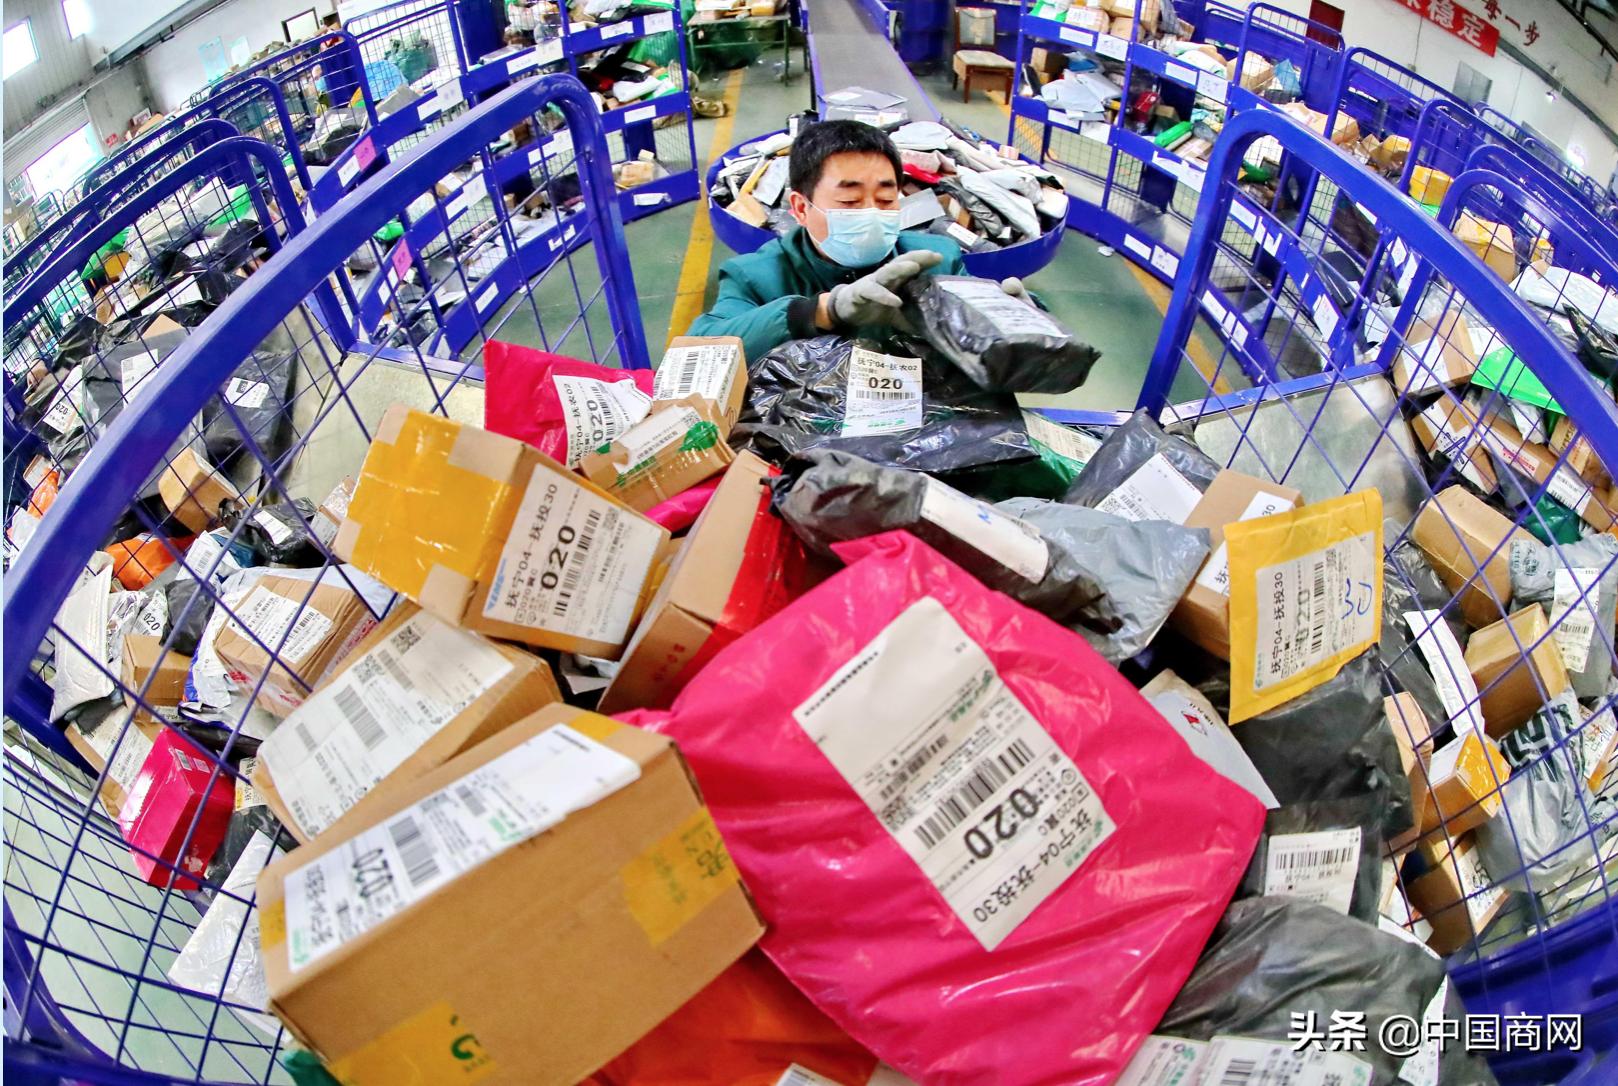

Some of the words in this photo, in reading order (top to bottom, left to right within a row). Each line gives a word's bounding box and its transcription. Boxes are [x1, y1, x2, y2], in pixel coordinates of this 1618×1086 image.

[868, 376, 903, 390] 020
[586, 398, 603, 444] 020
[504, 484, 558, 608] 抚宁04-抚投30
[540, 525, 577, 589] 020
[143, 613, 161, 632] 020
[1271, 571, 1284, 674] 抚宁04-抚投30
[1294, 589, 1311, 642] 020
[962, 787, 1038, 861] 020
[352, 848, 395, 898] 020
[973, 808, 1091, 924] 抚宁04-抚投30
